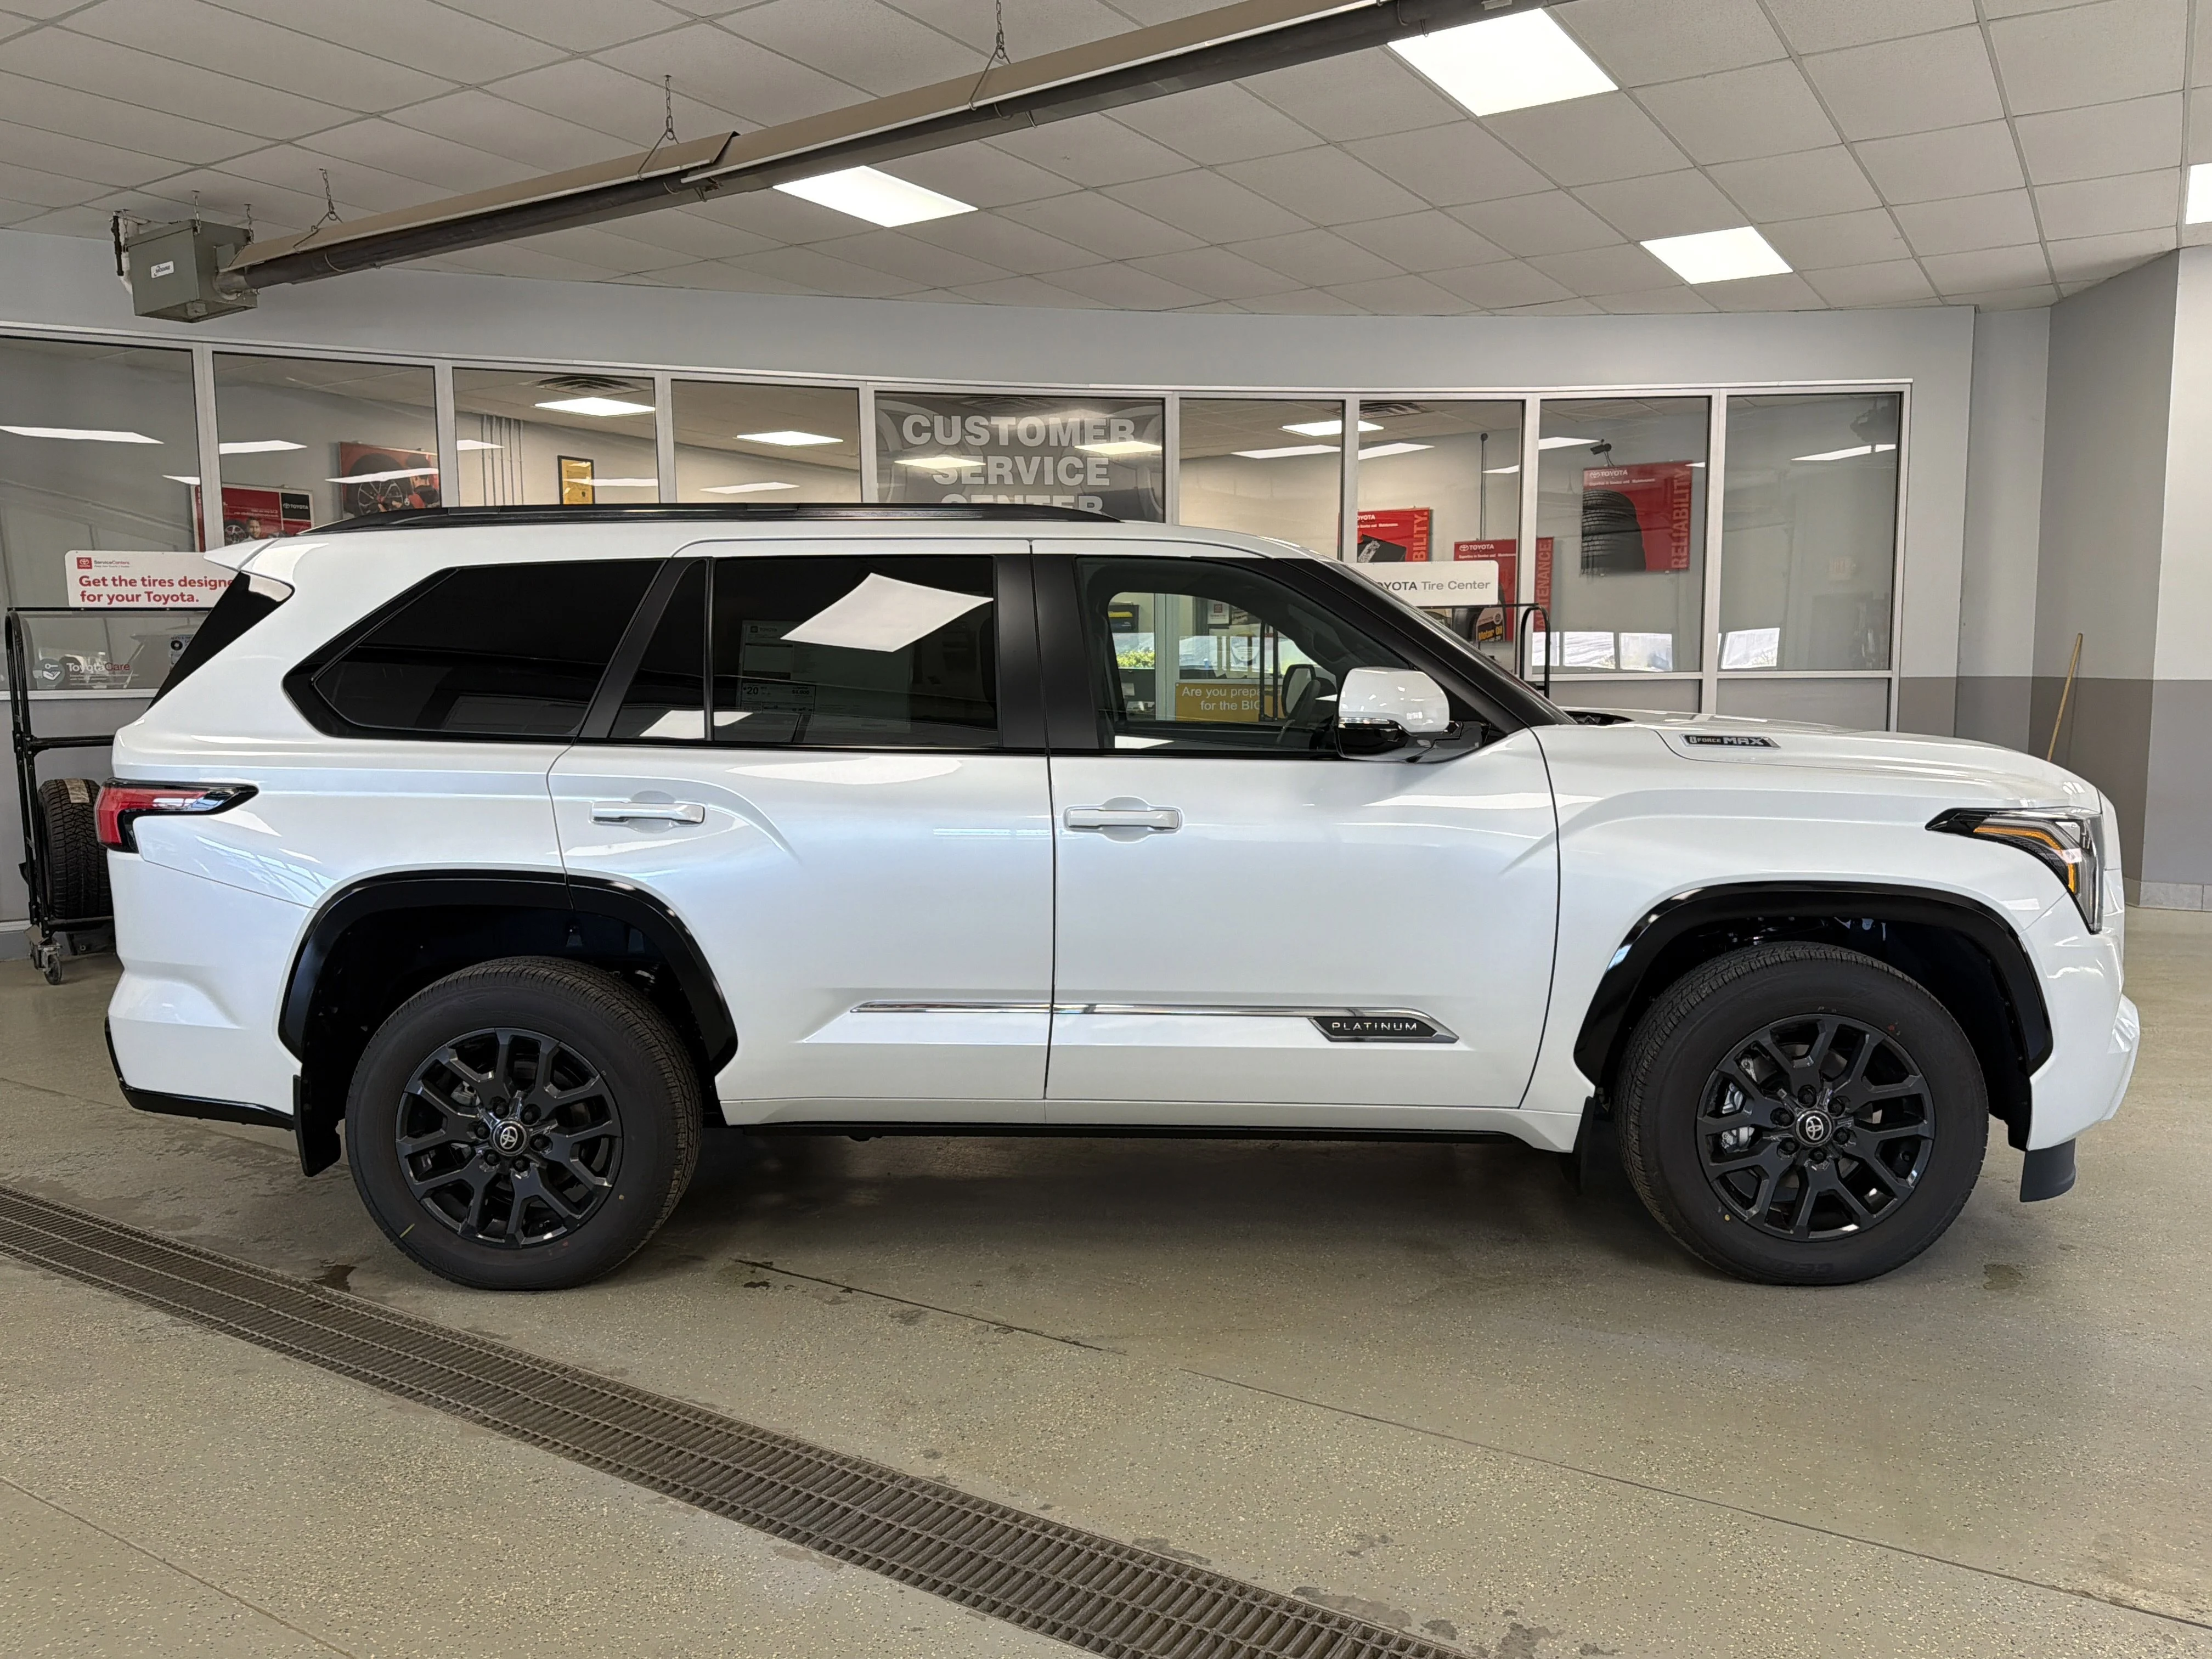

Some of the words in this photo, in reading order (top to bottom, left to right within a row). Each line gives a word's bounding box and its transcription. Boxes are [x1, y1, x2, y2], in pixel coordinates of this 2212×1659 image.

[902, 414, 1135, 447] CUSTOMER
[933, 455, 1110, 486] SERVICE
[1602, 469, 1628, 477] TOYOTA
[1413, 512, 1427, 561] BILITY.
[79, 575, 108, 587] Get
[111, 575, 137, 587] the
[141, 576, 174, 587] tires
[178, 575, 233, 590] designe
[1421, 580, 1444, 590] Tire
[1447, 580, 1491, 590] Center
[80, 590, 103, 602] for
[106, 593, 142, 605] your
[144, 591, 199, 605] Toyota.
[66, 662, 129, 674] ToyotaCare
[1182, 687, 1203, 697] Are
[1206, 689, 1227, 698] you
[1200, 701, 1216, 710] for
[1220, 701, 1238, 710] the
[1723, 737, 1764, 745] MAX
[1331, 1022, 1417, 1031] PLATINUM
